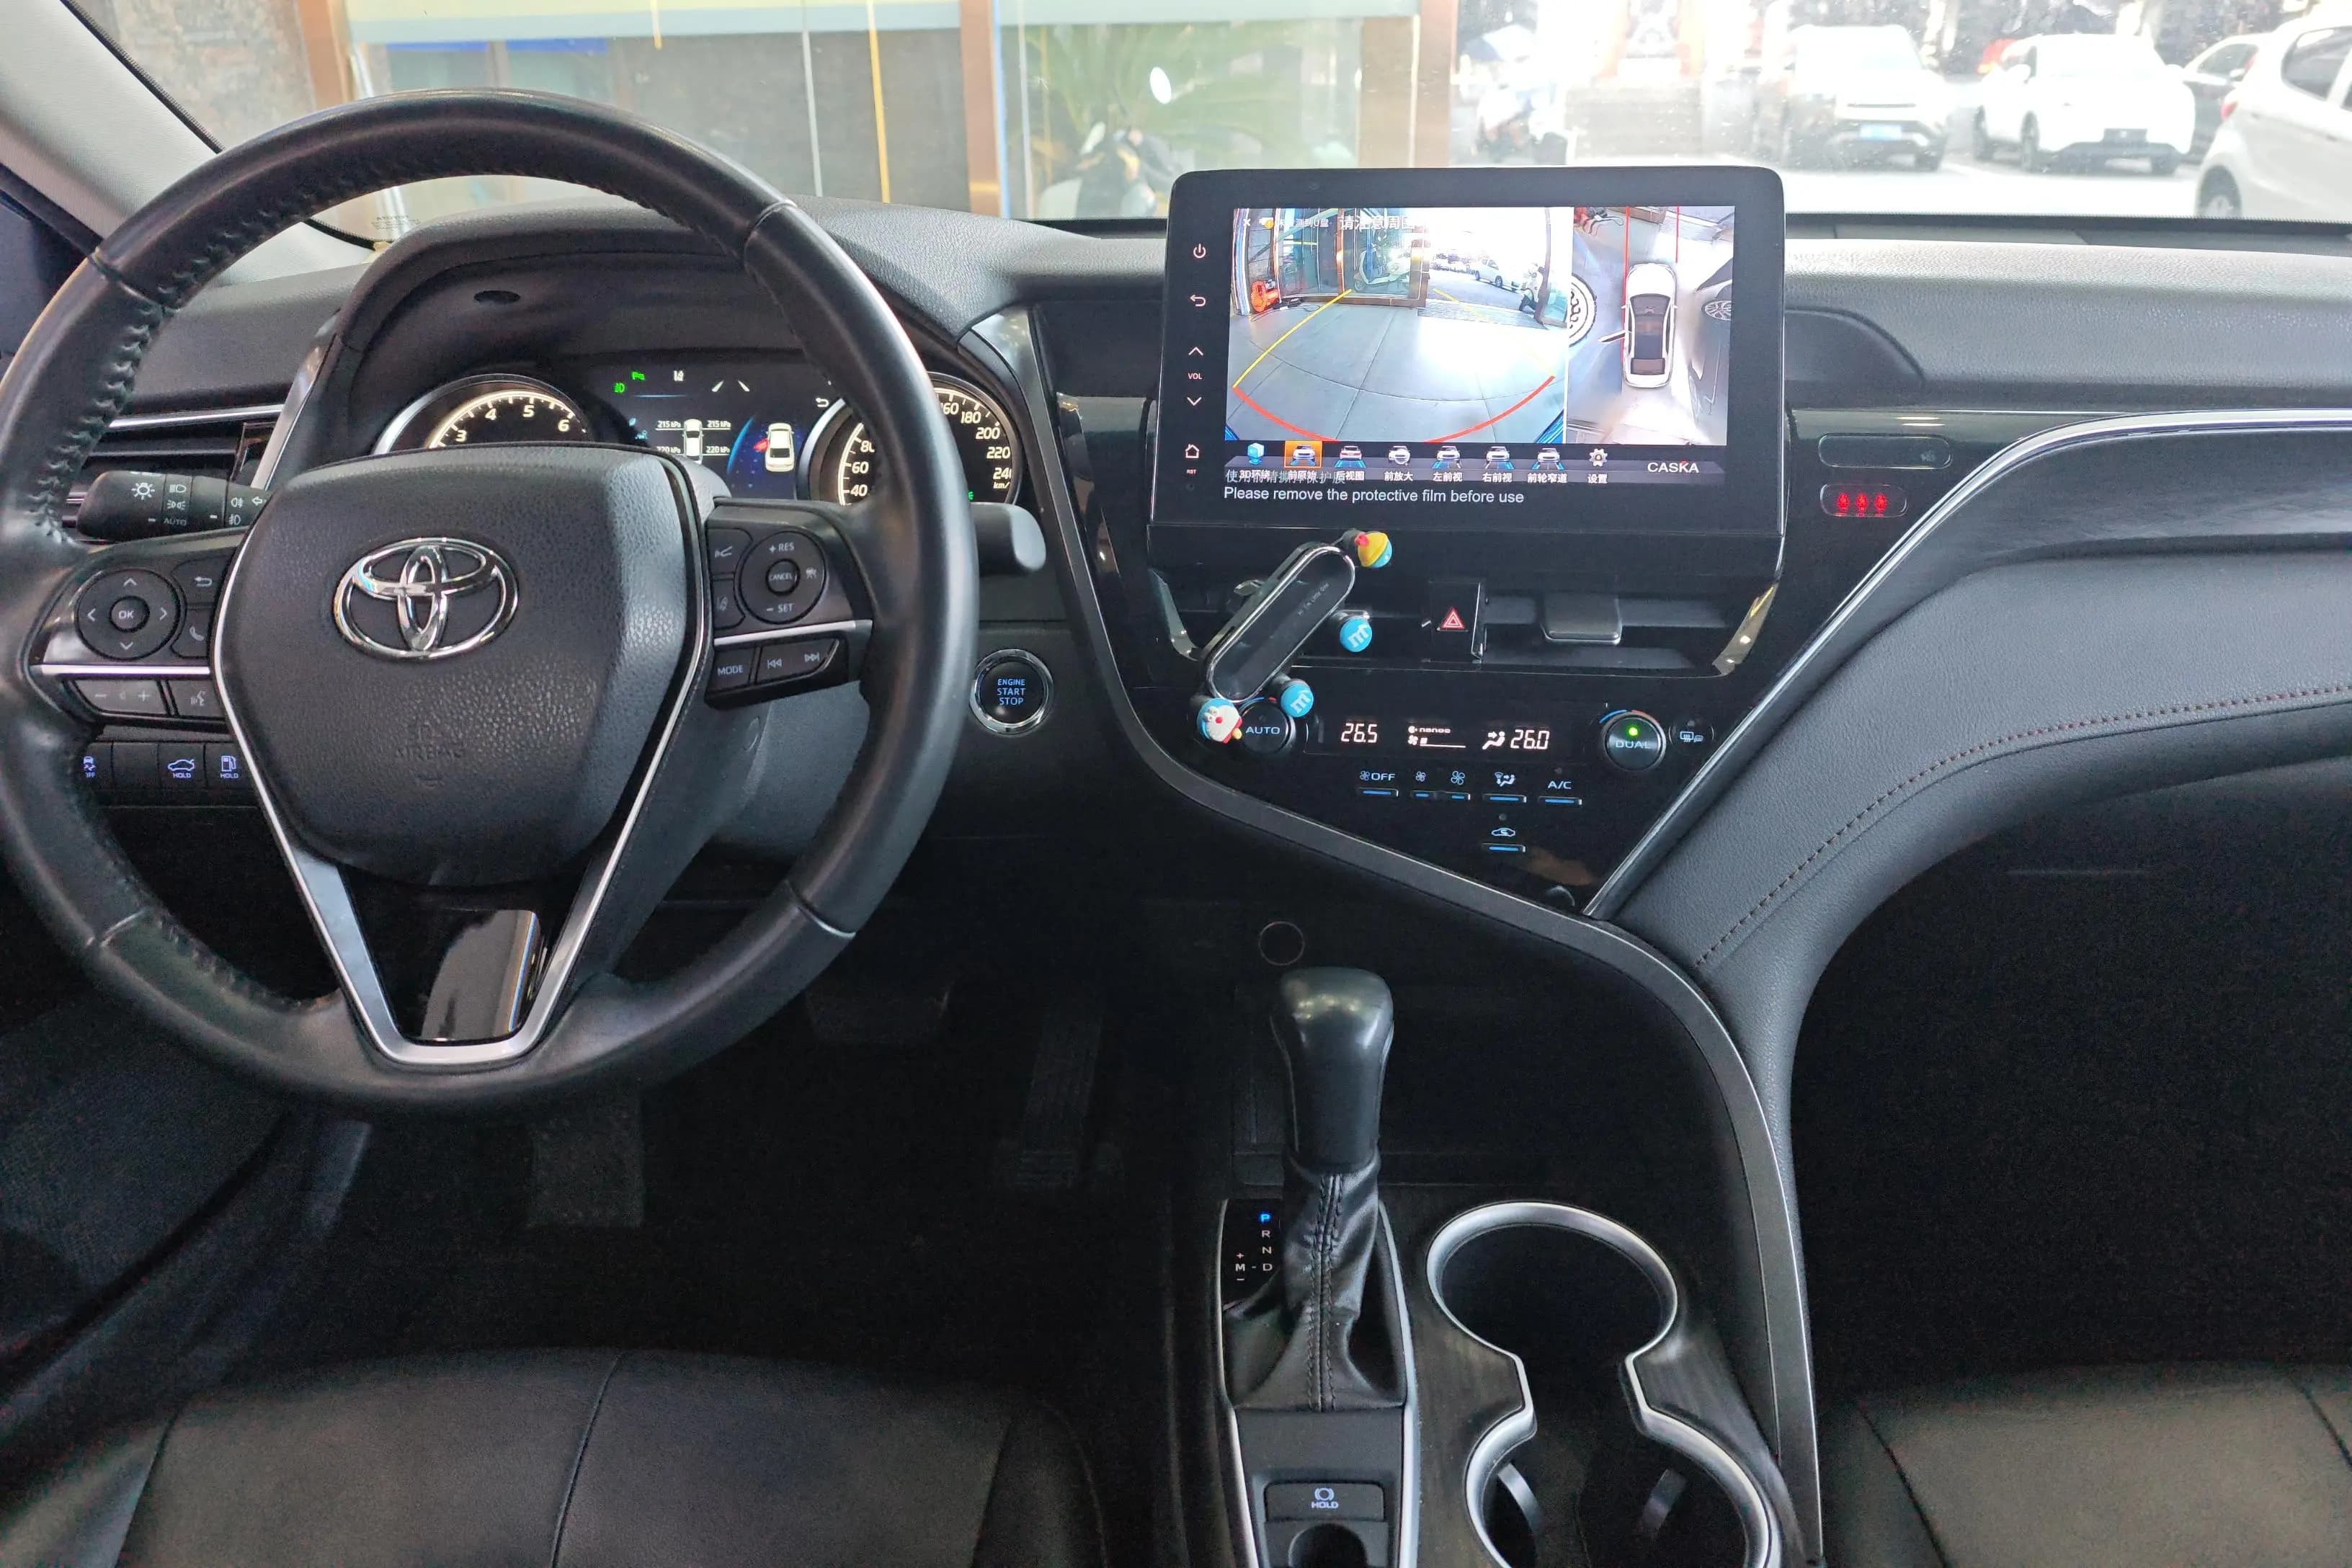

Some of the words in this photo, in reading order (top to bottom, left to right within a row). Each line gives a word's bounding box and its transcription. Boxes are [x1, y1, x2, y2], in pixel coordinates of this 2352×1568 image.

[485, 408, 497, 420] 4
[523, 405, 535, 418] 5
[961, 411, 981, 424] 180
[558, 419, 569, 432] 6
[455, 430, 467, 442] 3
[976, 427, 1000, 440] 200
[986, 446, 1010, 459] 220
[852, 461, 869, 473] 60
[1647, 461, 1699, 473] CASKA
[1336, 471, 1365, 481] 后视图
[1384, 471, 1414, 481] 前放大
[1433, 472, 1463, 482] 左前视
[1482, 473, 1512, 483] 右前视
[1527, 473, 1567, 484] 前轮窄道
[1587, 473, 1608, 484] 设置
[850, 484, 868, 496] 40
[1224, 486, 1269, 499] Please
[1273, 490, 1322, 500] remove
[1327, 488, 1348, 500] the
[1352, 488, 1417, 503] protective
[1422, 489, 1446, 502] film
[1451, 489, 1494, 502] before
[1499, 493, 1524, 503] use
[164, 517, 187, 526] AUTO
[778, 542, 795, 552] RES
[768, 572, 793, 582] CANCEL
[778, 603, 793, 612] SET
[118, 610, 134, 619] OK
[718, 664, 744, 676] MODE
[999, 697, 1024, 705] STOP
[1245, 726, 1280, 734] AUTO
[1341, 723, 1378, 743] 26.5
[1616, 740, 1652, 749] DUAL
[1371, 772, 1396, 781] OFF
[1547, 780, 1572, 790] A/C
[1260, 1213, 1270, 1223] P
[1261, 1229, 1271, 1238] R
[1235, 1263, 1246, 1272] M
[1262, 1262, 1273, 1271] D
